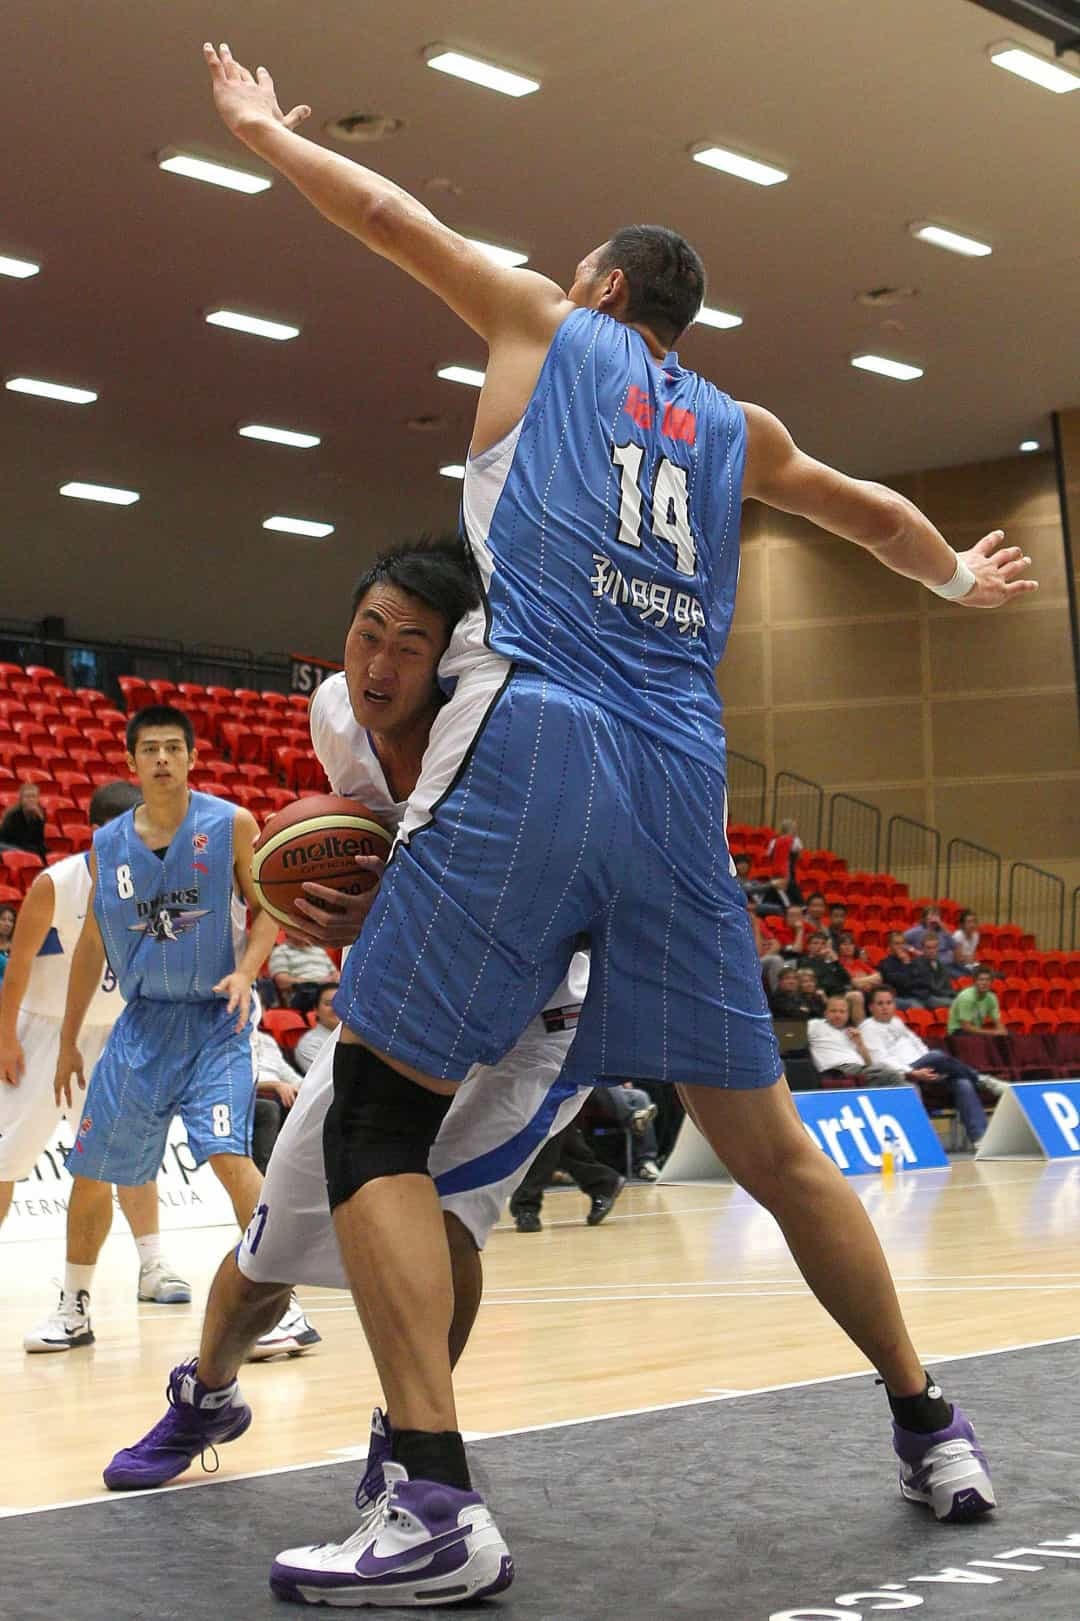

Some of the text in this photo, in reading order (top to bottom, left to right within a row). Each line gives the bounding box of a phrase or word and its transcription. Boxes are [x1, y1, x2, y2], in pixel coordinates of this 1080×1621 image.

[612, 441, 697, 577] 14
[590, 553, 706, 638] 孙明明
[282, 837, 373, 869] molten
[116, 863, 135, 900] 8
[212, 1104, 232, 1137] 8
[803, 1095, 918, 1169] rth
[13, 1198, 69, 1217] TERN
